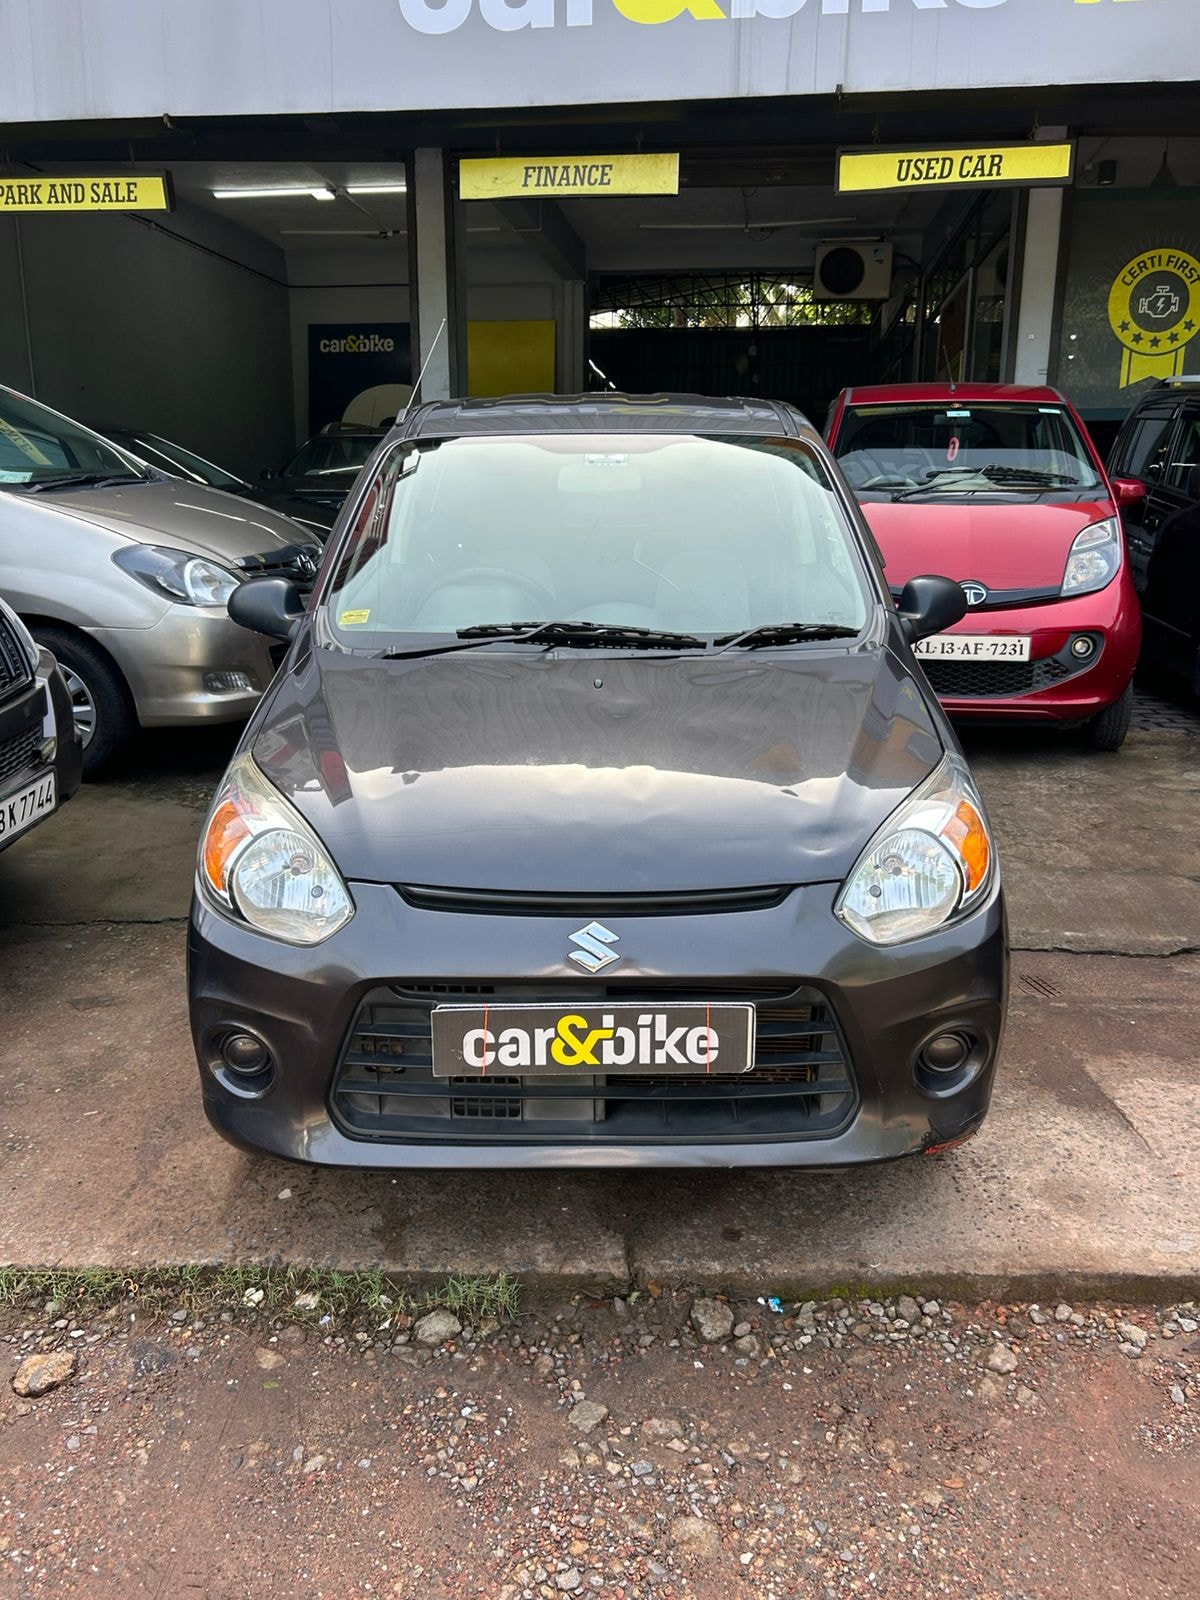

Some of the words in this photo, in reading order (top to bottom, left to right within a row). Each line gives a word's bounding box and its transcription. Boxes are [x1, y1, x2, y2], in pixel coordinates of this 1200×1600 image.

[522, 164, 613, 187] FINANCE
[897, 157, 954, 181] USED
[959, 154, 1003, 178] CAR
[47, 183, 85, 204] AND
[91, 182, 137, 203] SALE
[1121, 255, 1162, 286] CERTI
[1166, 255, 1200, 285] FIRST
[320, 335, 394, 352] car&bike
[20, 780, 52, 823] 7744
[463, 1014, 719, 1066] car&bike
